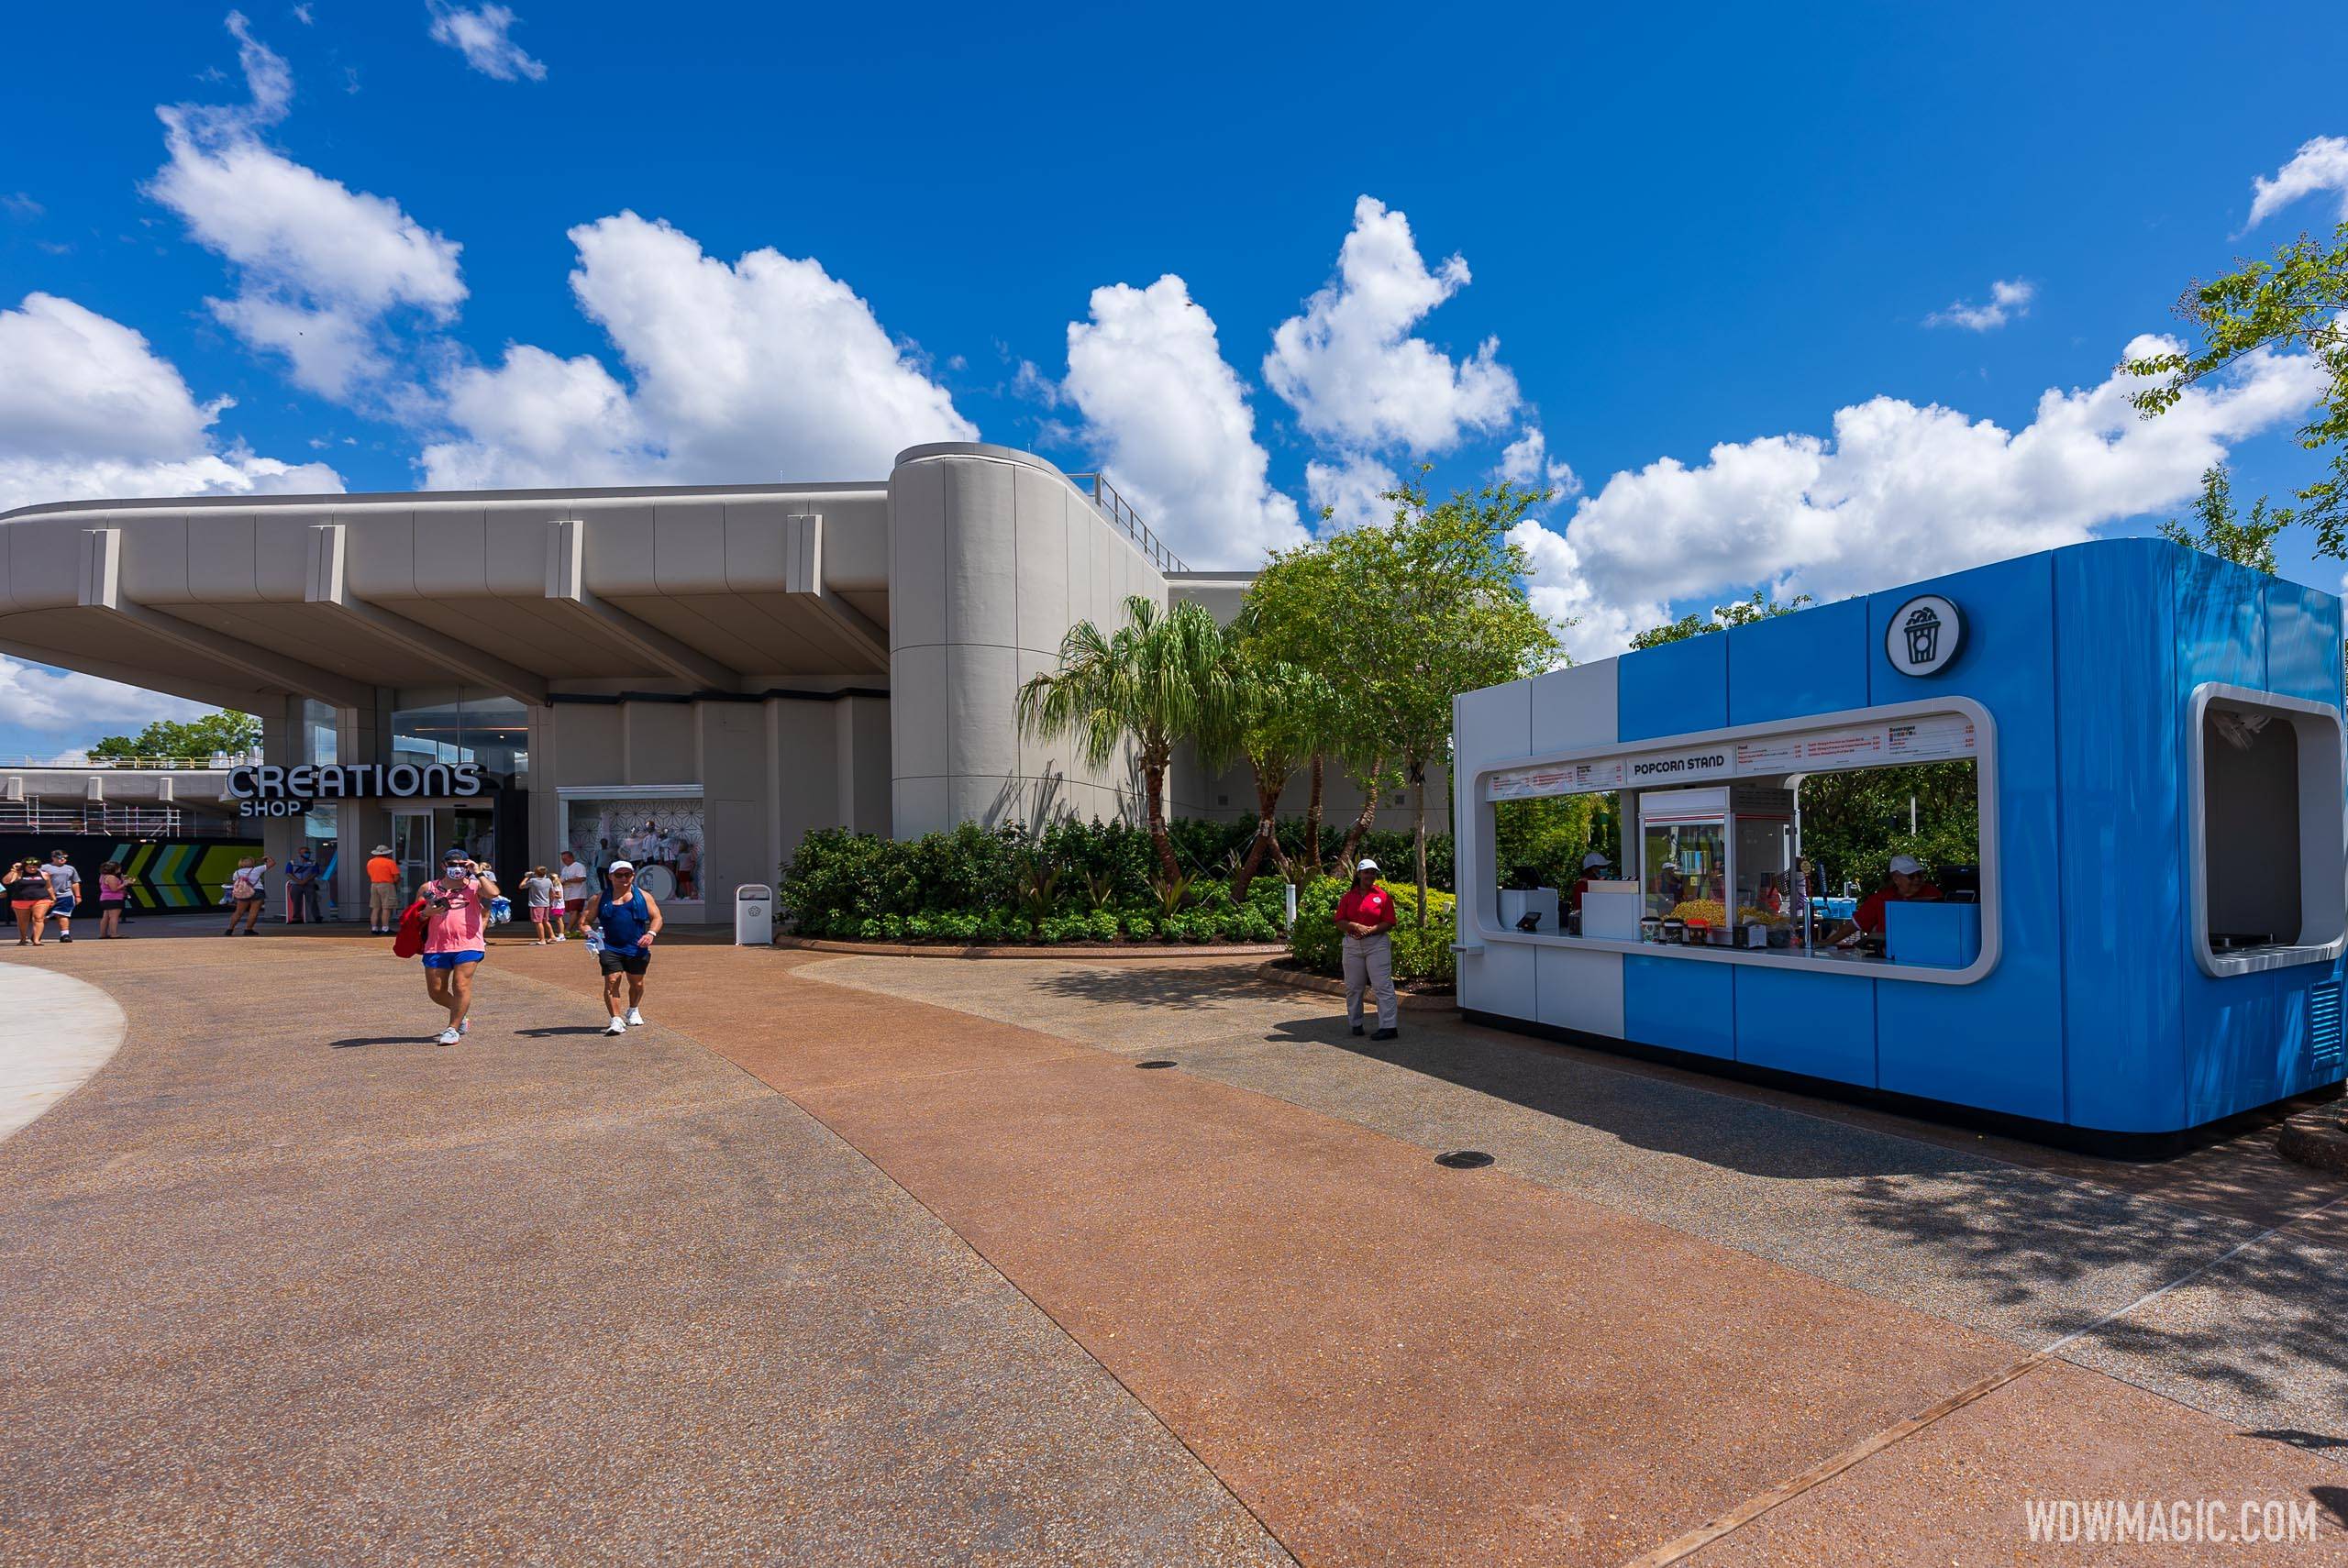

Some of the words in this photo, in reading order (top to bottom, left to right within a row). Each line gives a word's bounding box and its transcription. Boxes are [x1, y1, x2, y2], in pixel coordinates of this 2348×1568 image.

[1634, 760, 1685, 775] POPCORN
[1688, 755, 1724, 769] STAND
[228, 763, 482, 798] CREATIONS
[240, 801, 301, 817] SHOP
